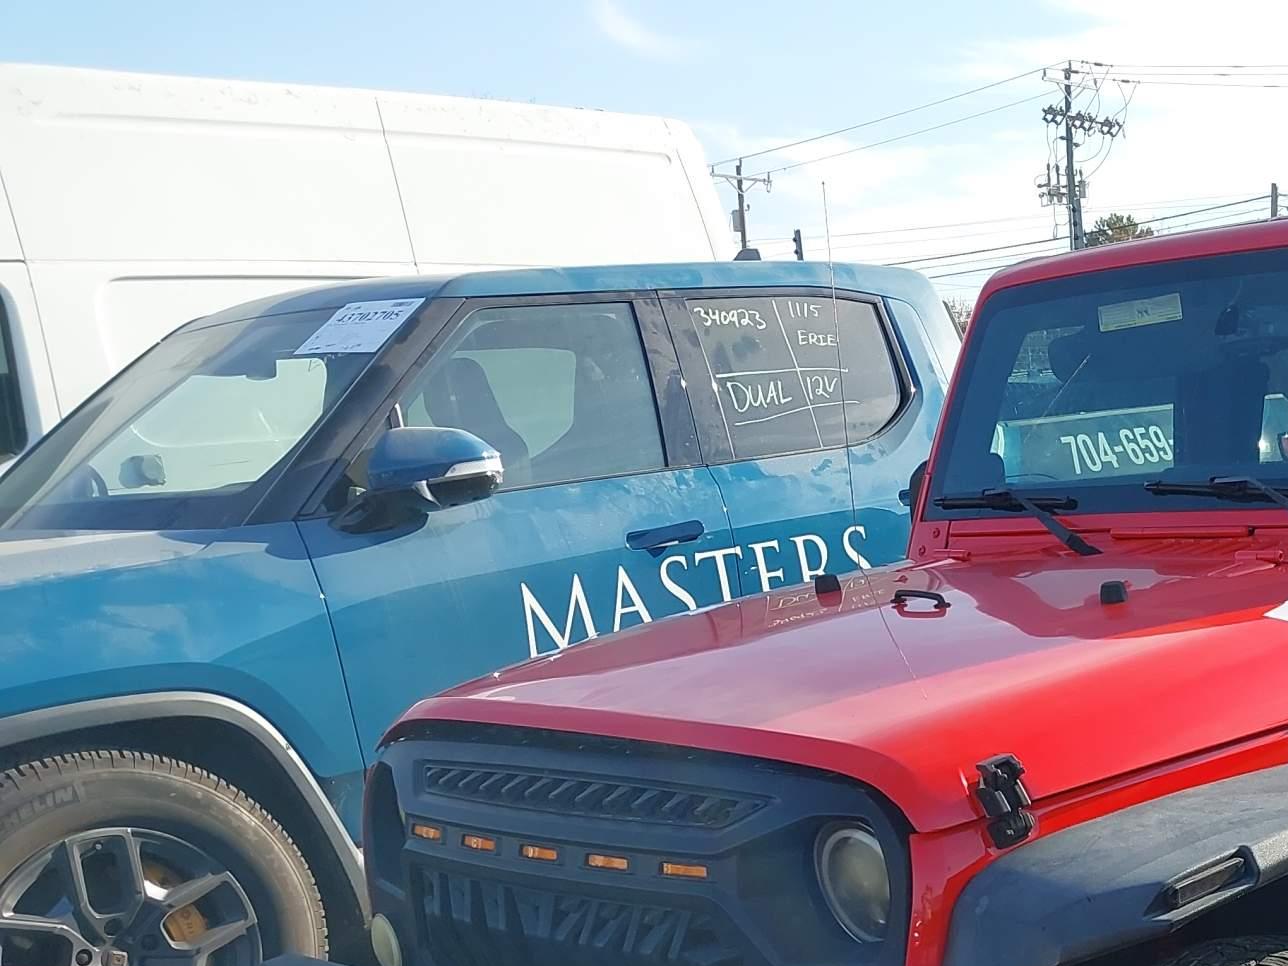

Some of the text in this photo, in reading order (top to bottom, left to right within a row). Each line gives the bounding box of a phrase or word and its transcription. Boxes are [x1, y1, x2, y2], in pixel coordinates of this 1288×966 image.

[694, 306, 767, 331] 340923
[798, 330, 838, 346] ERIE
[726, 381, 793, 413] DUAL
[806, 375, 838, 400] 12V
[520, 525, 873, 659] MASTERS
